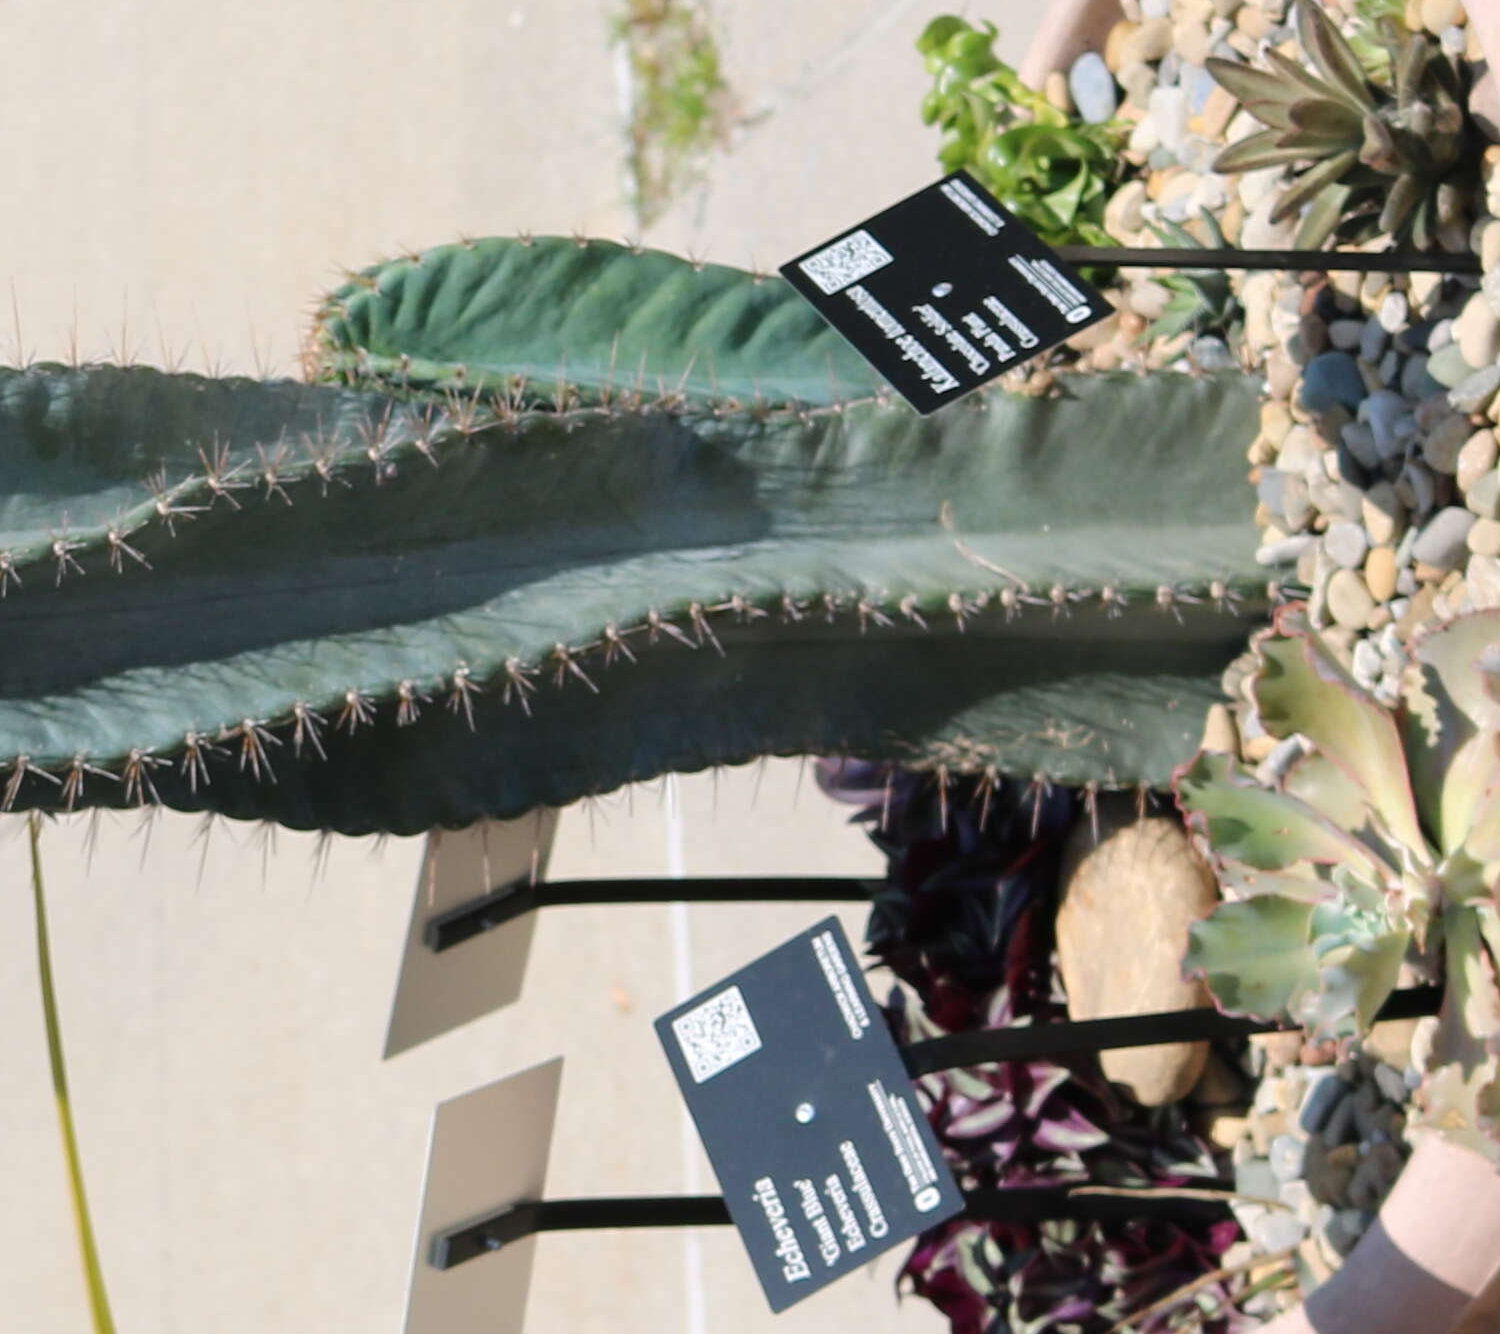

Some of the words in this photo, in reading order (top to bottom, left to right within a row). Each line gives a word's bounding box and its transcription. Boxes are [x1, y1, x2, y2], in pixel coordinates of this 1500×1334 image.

[752, 1176, 810, 1282] Echeveria
[824, 1173, 865, 1251] Echeveria
[839, 1140, 888, 1237] Crassulaceae
